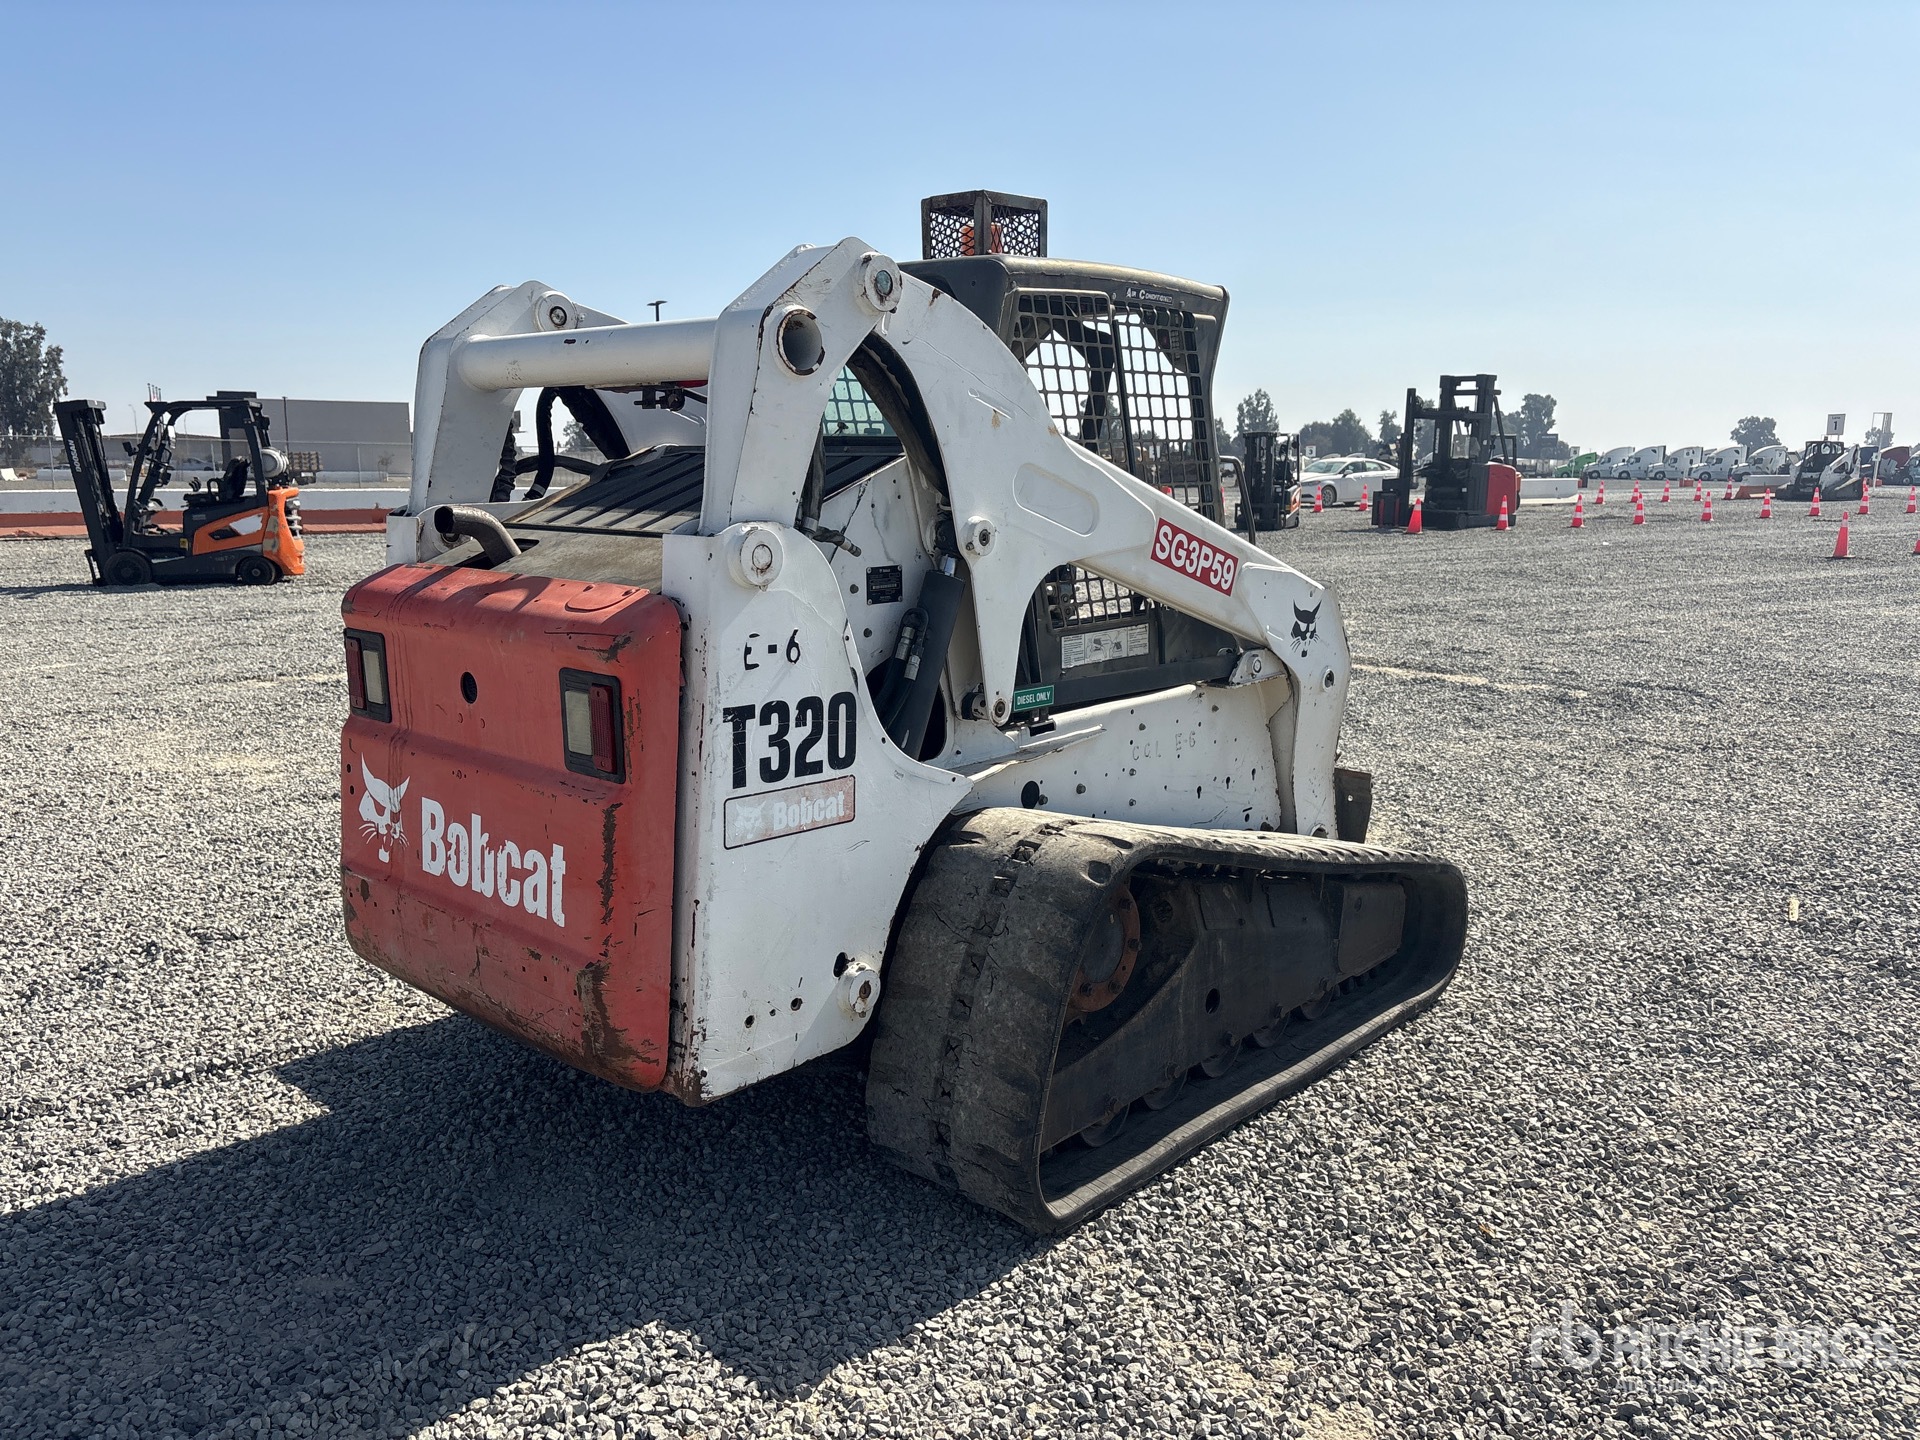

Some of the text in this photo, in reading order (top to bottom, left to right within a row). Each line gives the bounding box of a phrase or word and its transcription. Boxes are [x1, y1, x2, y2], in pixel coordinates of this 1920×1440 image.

[1833, 420, 1838, 431] 1
[68, 439, 81, 472] DOOSAN
[1155, 524, 1235, 590] SG3P59
[743, 628, 801, 671] E-6
[1016, 690, 1051, 706] DIESEL ONLY
[723, 691, 857, 789] T320
[773, 790, 845, 831] Bobcat
[421, 796, 566, 928] Bobcat
